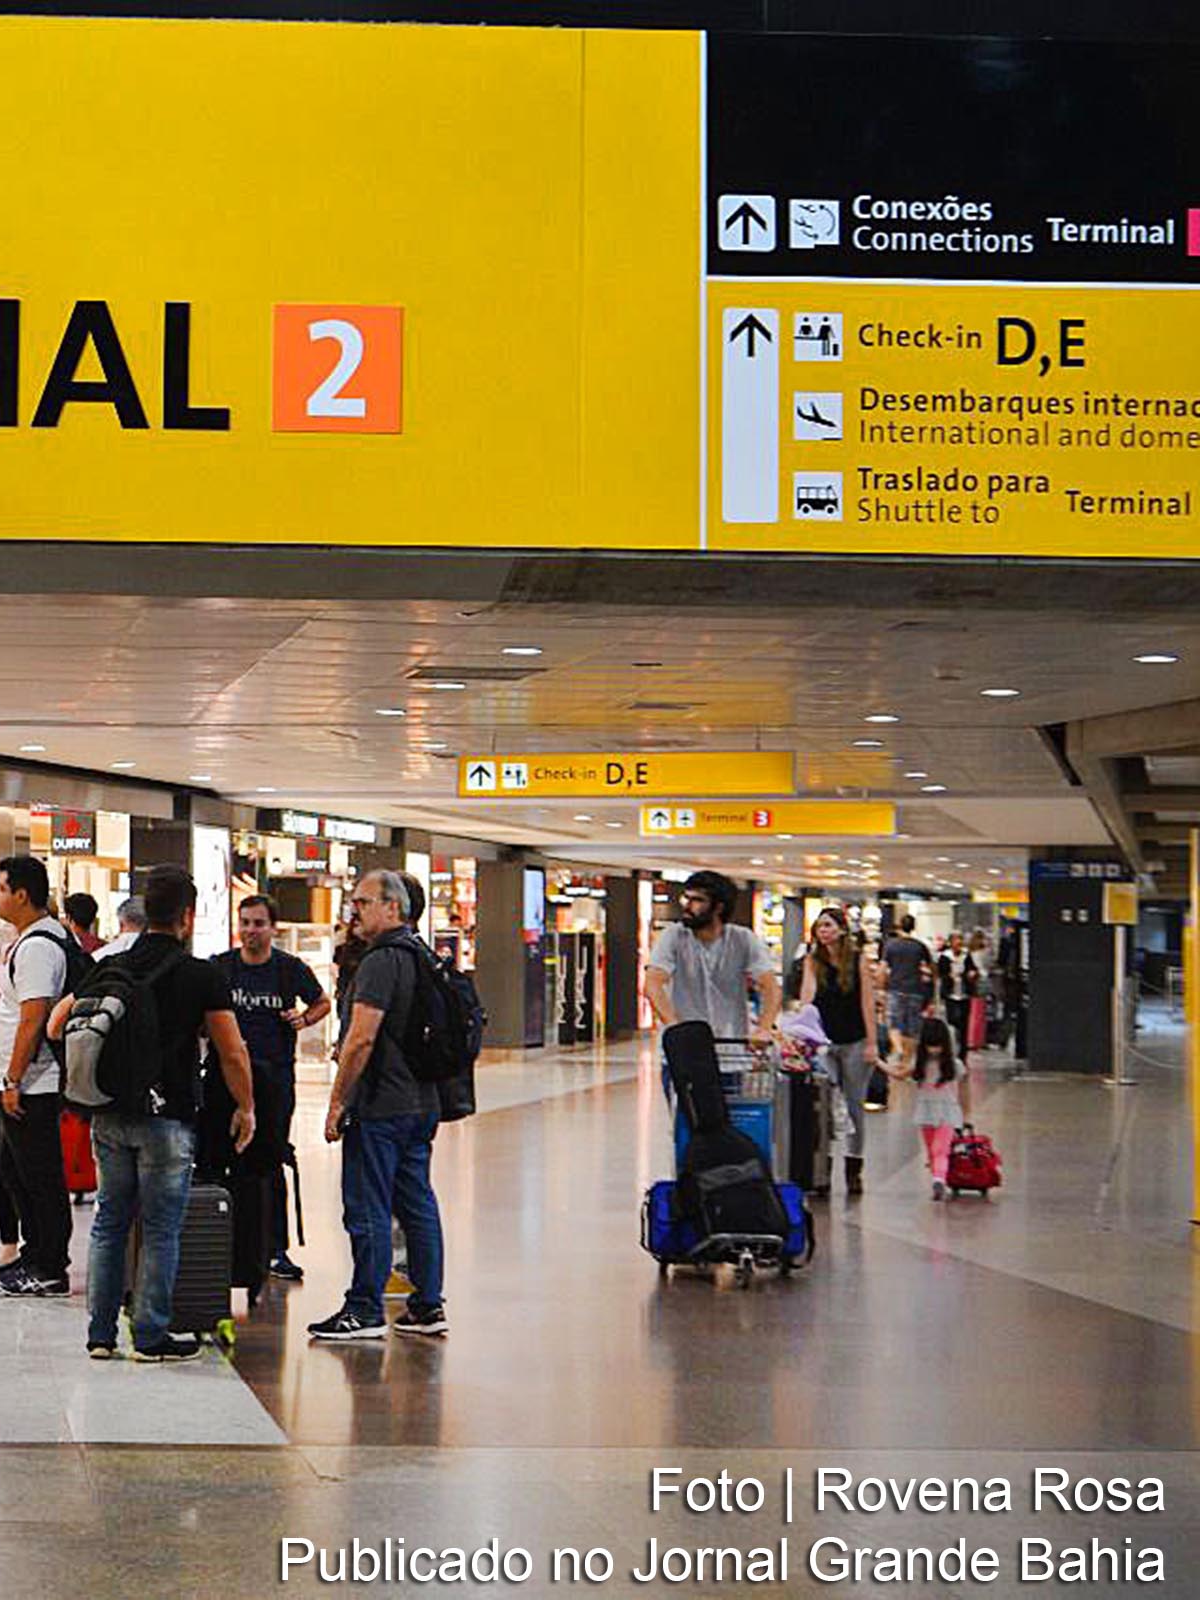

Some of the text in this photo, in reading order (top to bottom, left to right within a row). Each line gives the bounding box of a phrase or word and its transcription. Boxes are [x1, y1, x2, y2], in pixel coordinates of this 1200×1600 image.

[852, 194, 993, 222] Conexões
[852, 226, 1034, 253] Connections
[1046, 217, 1175, 245] Terminal
[858, 317, 1086, 376] Check-in D,E
[306, 319, 367, 418] 2
[860, 387, 1075, 422] Desembarques
[860, 420, 1049, 446] International
[1058, 423, 1111, 447] and
[857, 466, 1050, 499] Traslado para
[857, 497, 1000, 524] Shuttle to
[1065, 490, 1190, 516] Terminal
[606, 762, 649, 789] D,E
[755, 810, 769, 827] 3
